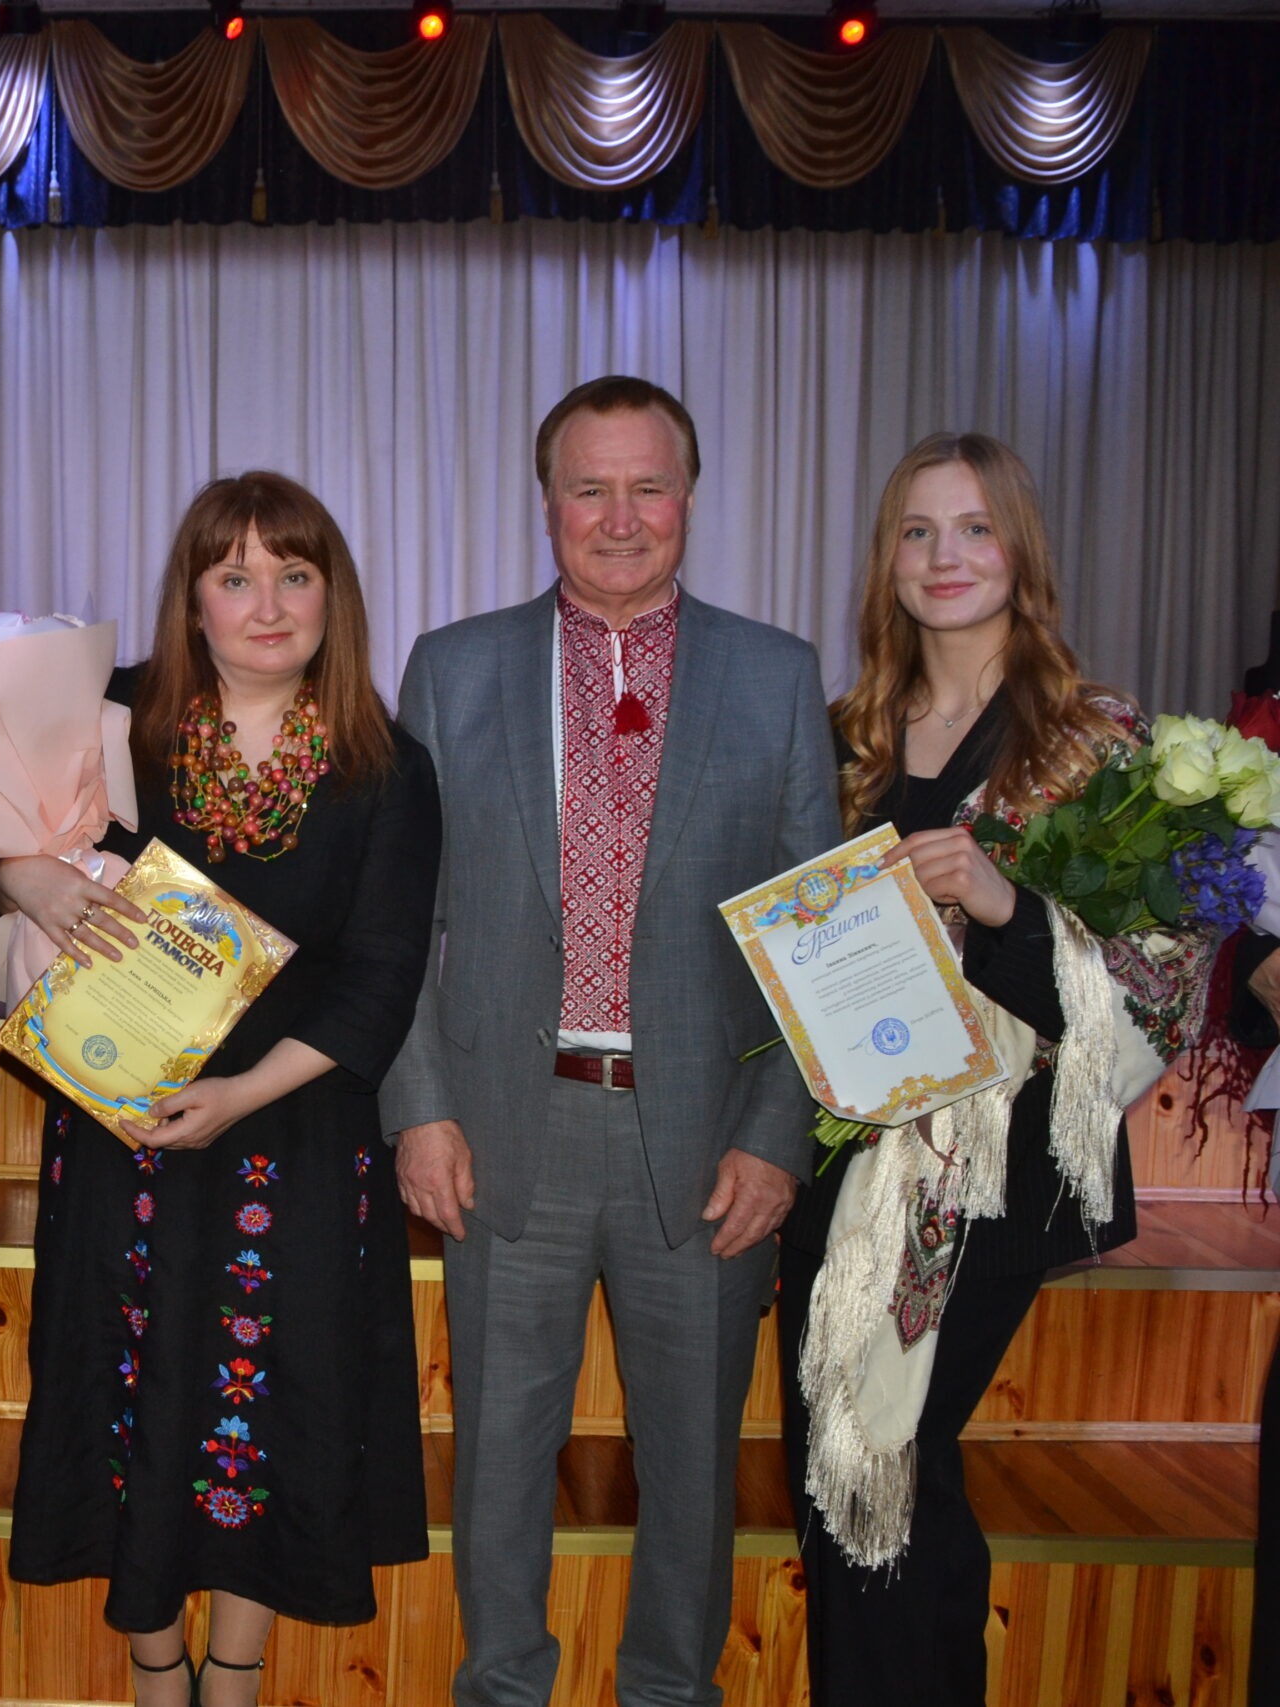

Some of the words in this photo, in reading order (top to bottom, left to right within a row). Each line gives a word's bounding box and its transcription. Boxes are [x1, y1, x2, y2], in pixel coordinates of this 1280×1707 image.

[146, 907, 225, 978] ПОЧЕСНА
[146, 931, 205, 979] ГРАМОТА
[791, 904, 881, 965] Грамота
